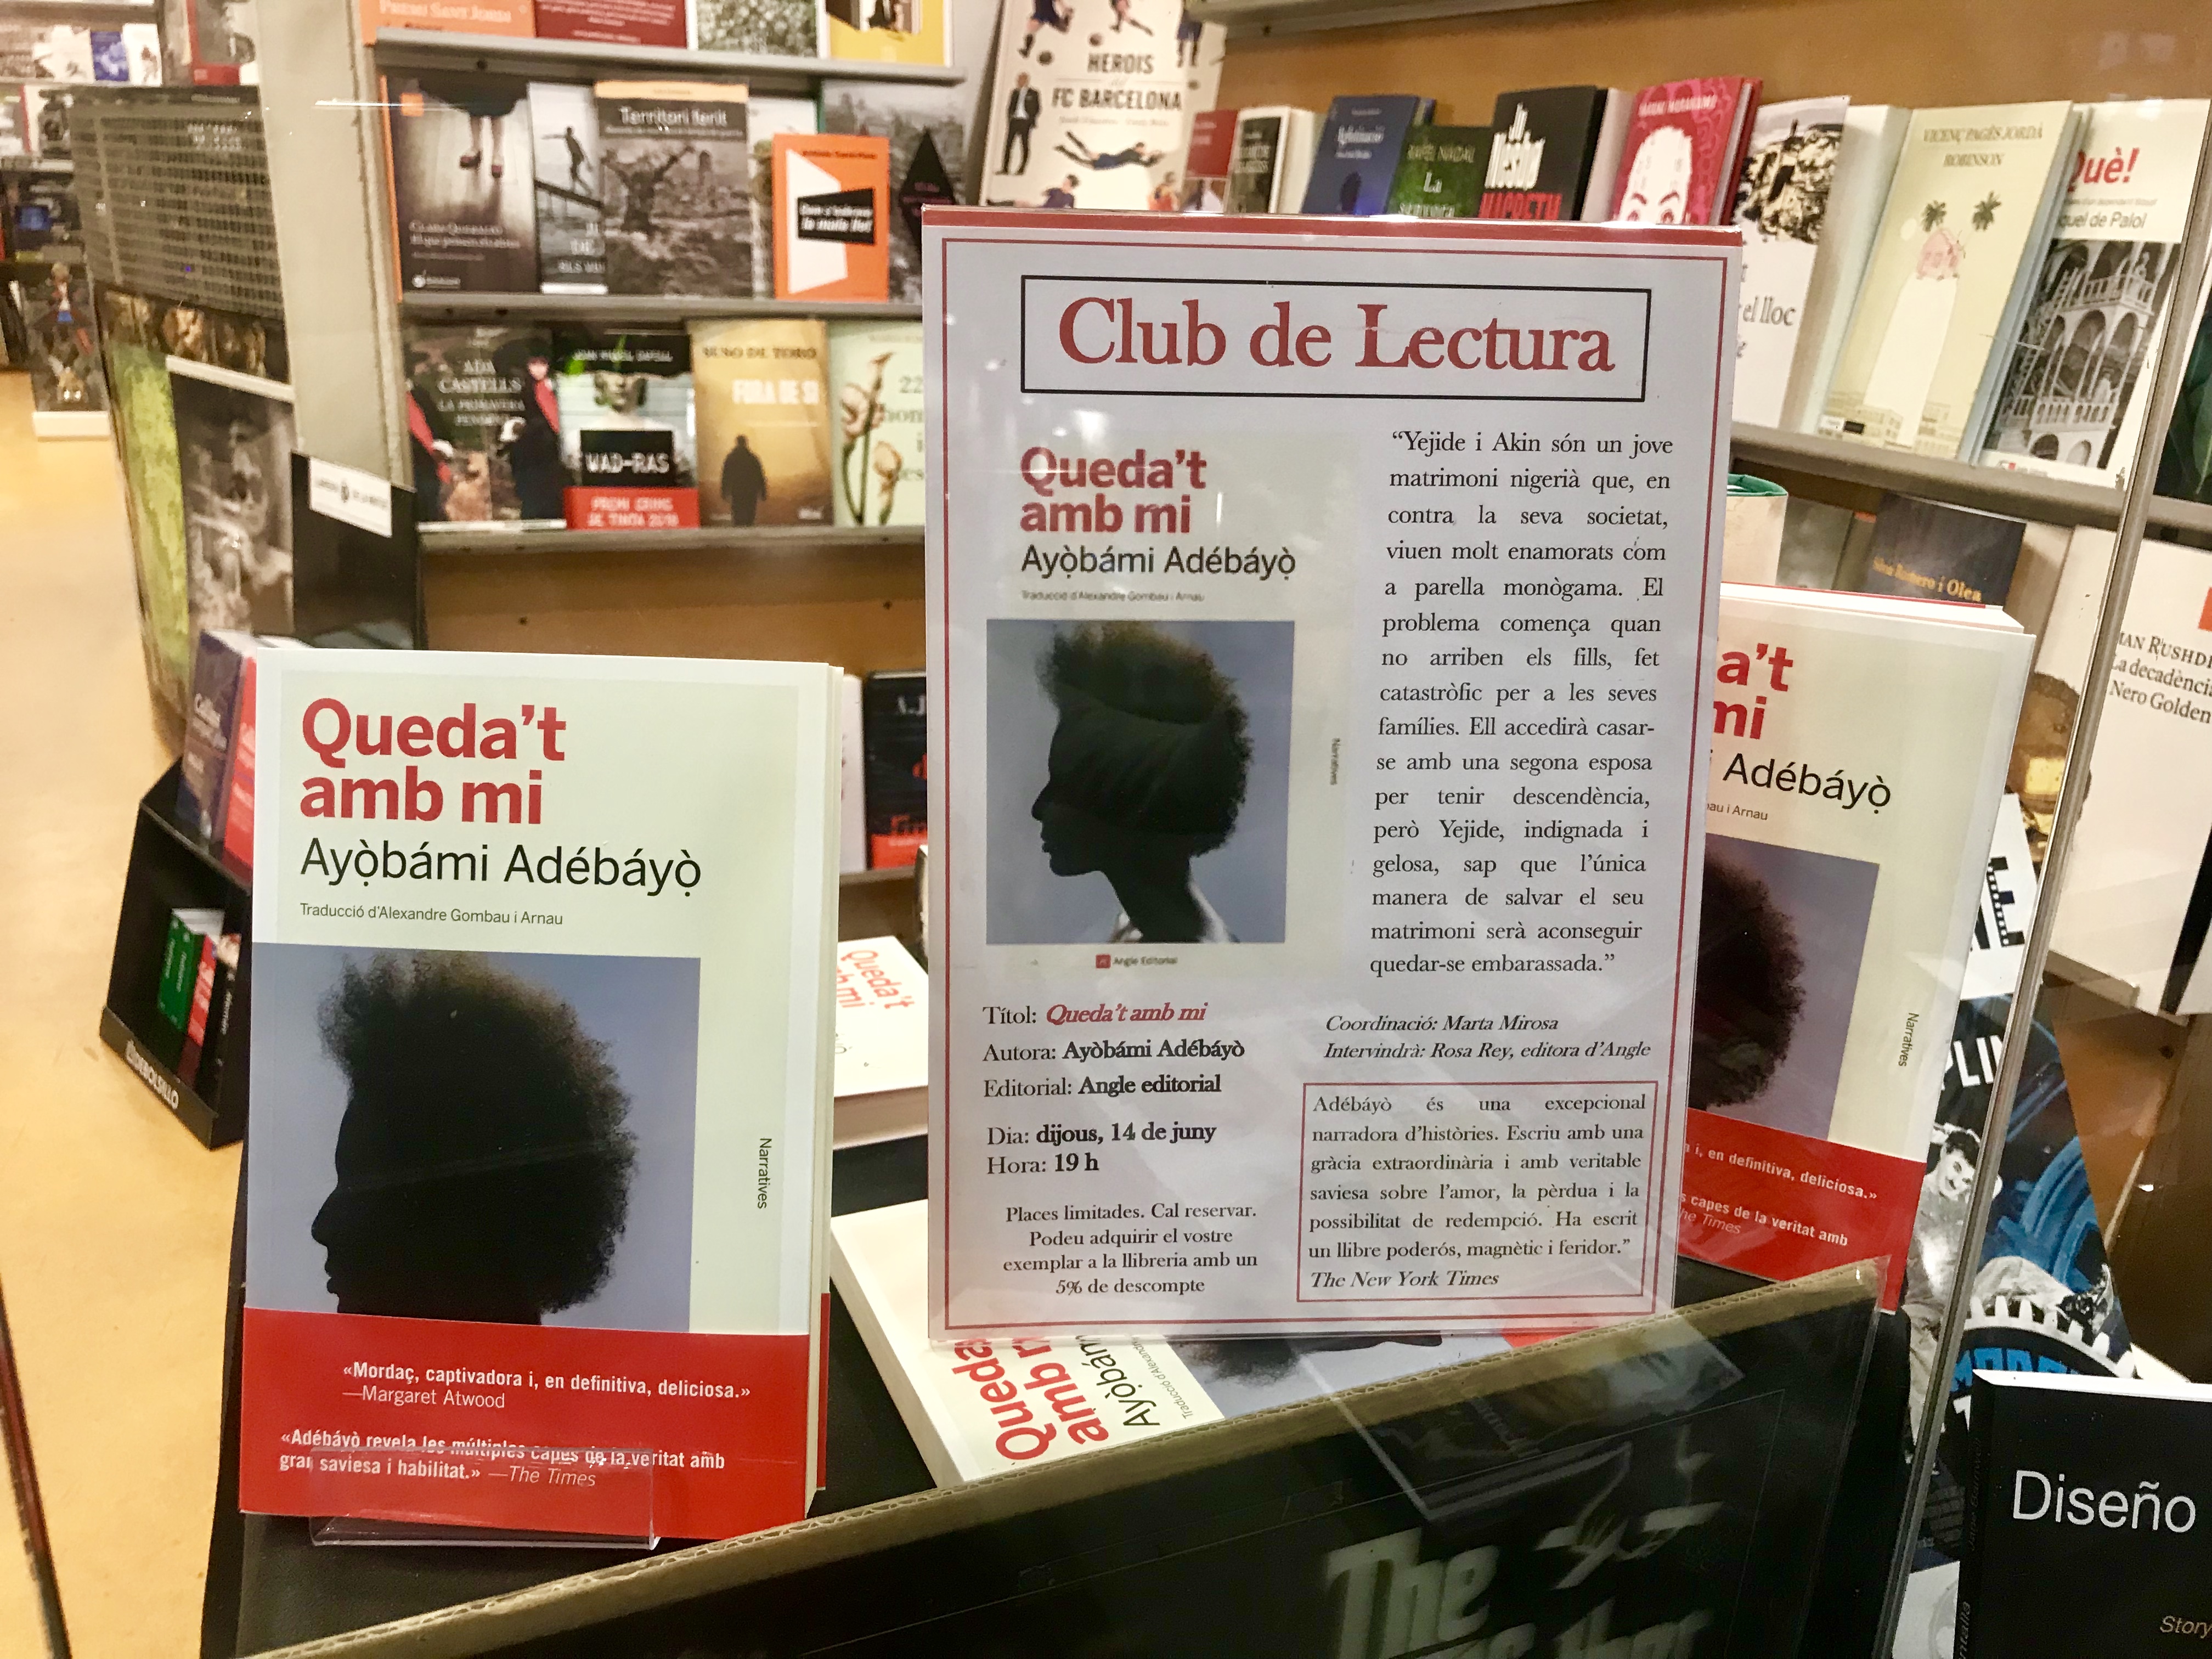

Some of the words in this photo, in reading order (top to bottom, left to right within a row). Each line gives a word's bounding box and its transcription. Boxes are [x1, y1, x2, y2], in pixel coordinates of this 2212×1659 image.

[1087, 53, 1154, 74] HEROIS
[1051, 88, 1074, 108] FC
[1077, 88, 1182, 110] BARCELONA
[2089, 211, 2108, 228] de
[1742, 295, 1760, 323] el
[1759, 295, 1796, 326] lloc
[1059, 297, 1226, 366] Club
[1250, 301, 1331, 367] de
[1355, 304, 1616, 371] Lectura
[1393, 431, 1465, 457] “Yejide
[1475, 432, 1482, 452] i
[1492, 432, 1541, 452] Akin
[1551, 433, 1585, 452] són
[1597, 441, 1622, 452] un
[1629, 433, 1673, 459] jove
[585, 452, 670, 474] WAD-RAS
[1020, 493, 1123, 533] amb
[1134, 495, 1191, 533] mi
[2109, 680, 2148, 706] Nero
[2149, 691, 2211, 724] Golden
[300, 766, 444, 822] amb
[461, 770, 542, 824] mi
[1732, 805, 1769, 821] Arnau
[301, 902, 364, 918] Traducció
[451, 909, 510, 923] Gombau
[514, 911, 518, 923] i
[521, 911, 563, 925] Arnau
[983, 1006, 1036, 1024] Títol:
[1130, 1002, 1175, 1021] amb
[1177, 1002, 1208, 1022] mi
[983, 1044, 1056, 1061] Autora:
[1062, 1040, 1152, 1063] Ayòbámi
[1156, 1039, 1245, 1060] Adébáyò
[1897, 1012, 1919, 1067] Narratives
[984, 1077, 1071, 1097] Editorial:
[1077, 1075, 1136, 1097] Angle
[1141, 1074, 1222, 1093] editorial
[988, 1127, 1029, 1145] Dia:
[1036, 1124, 1103, 1146] dijous,
[1111, 1122, 1136, 1141] 14
[1142, 1121, 1166, 1140] de
[1169, 1122, 1217, 1144] juny
[757, 1137, 771, 1210] Narratives
[987, 1156, 1046, 1174] Hora:
[1055, 1153, 1079, 1172] 19
[1085, 1152, 1100, 1171] h
[1708, 1149, 1724, 1161] en
[1729, 1153, 1795, 1181] definitiva,
[1800, 1171, 1877, 1199] deliciosa.»
[1006, 1207, 1058, 1222] Places
[1064, 1204, 1144, 1220] limitades.
[1152, 1203, 1179, 1218] Cal
[1163, 1206, 1256, 1218] reservar.
[1690, 1196, 1729, 1215] capes
[1734, 1206, 1751, 1220] de
[1755, 1211, 1767, 1224] la
[1772, 1217, 1816, 1238] veritat
[1819, 1229, 1849, 1246] amb
[1702, 1212, 1742, 1234] Times
[1029, 1231, 1084, 1246] Podeu
[1090, 1229, 1158, 1248] adquirir
[1163, 1228, 1177, 1243] el
[1183, 1231, 1233, 1242] vostre
[1003, 1255, 1084, 1273] exemplar
[1088, 1259, 1097, 1268] a
[1103, 1254, 1117, 1268] la
[1122, 1252, 1188, 1268] llibreria
[1193, 1251, 1230, 1267] amb
[1236, 1256, 1257, 1266] un
[1056, 1280, 1082, 1295] 5%
[1088, 1279, 1108, 1293] de
[1114, 1278, 1205, 1295] descompte
[343, 1361, 419, 1384] «Mordaç,
[426, 1367, 522, 1386] captivadora
[529, 1370, 539, 1391] i,
[545, 1376, 563, 1389] en
[571, 1374, 651, 1397] definitiva,
[658, 1379, 750, 1398] deliciosa.»
[443, 1390, 504, 1408] Atwood
[1023, 1362, 1109, 1445] amb
[366, 1434, 417, 1449] revela
[422, 1435, 445, 1453] les
[631, 1449, 685, 1466] veritat
[690, 1451, 724, 1469] amb
[320, 1455, 380, 1474] saviesa
[386, 1458, 392, 1475] i
[398, 1459, 481, 1480] habilitat.»
[548, 1468, 596, 1487] Times
[2012, 1470, 2196, 1533] Diseño
